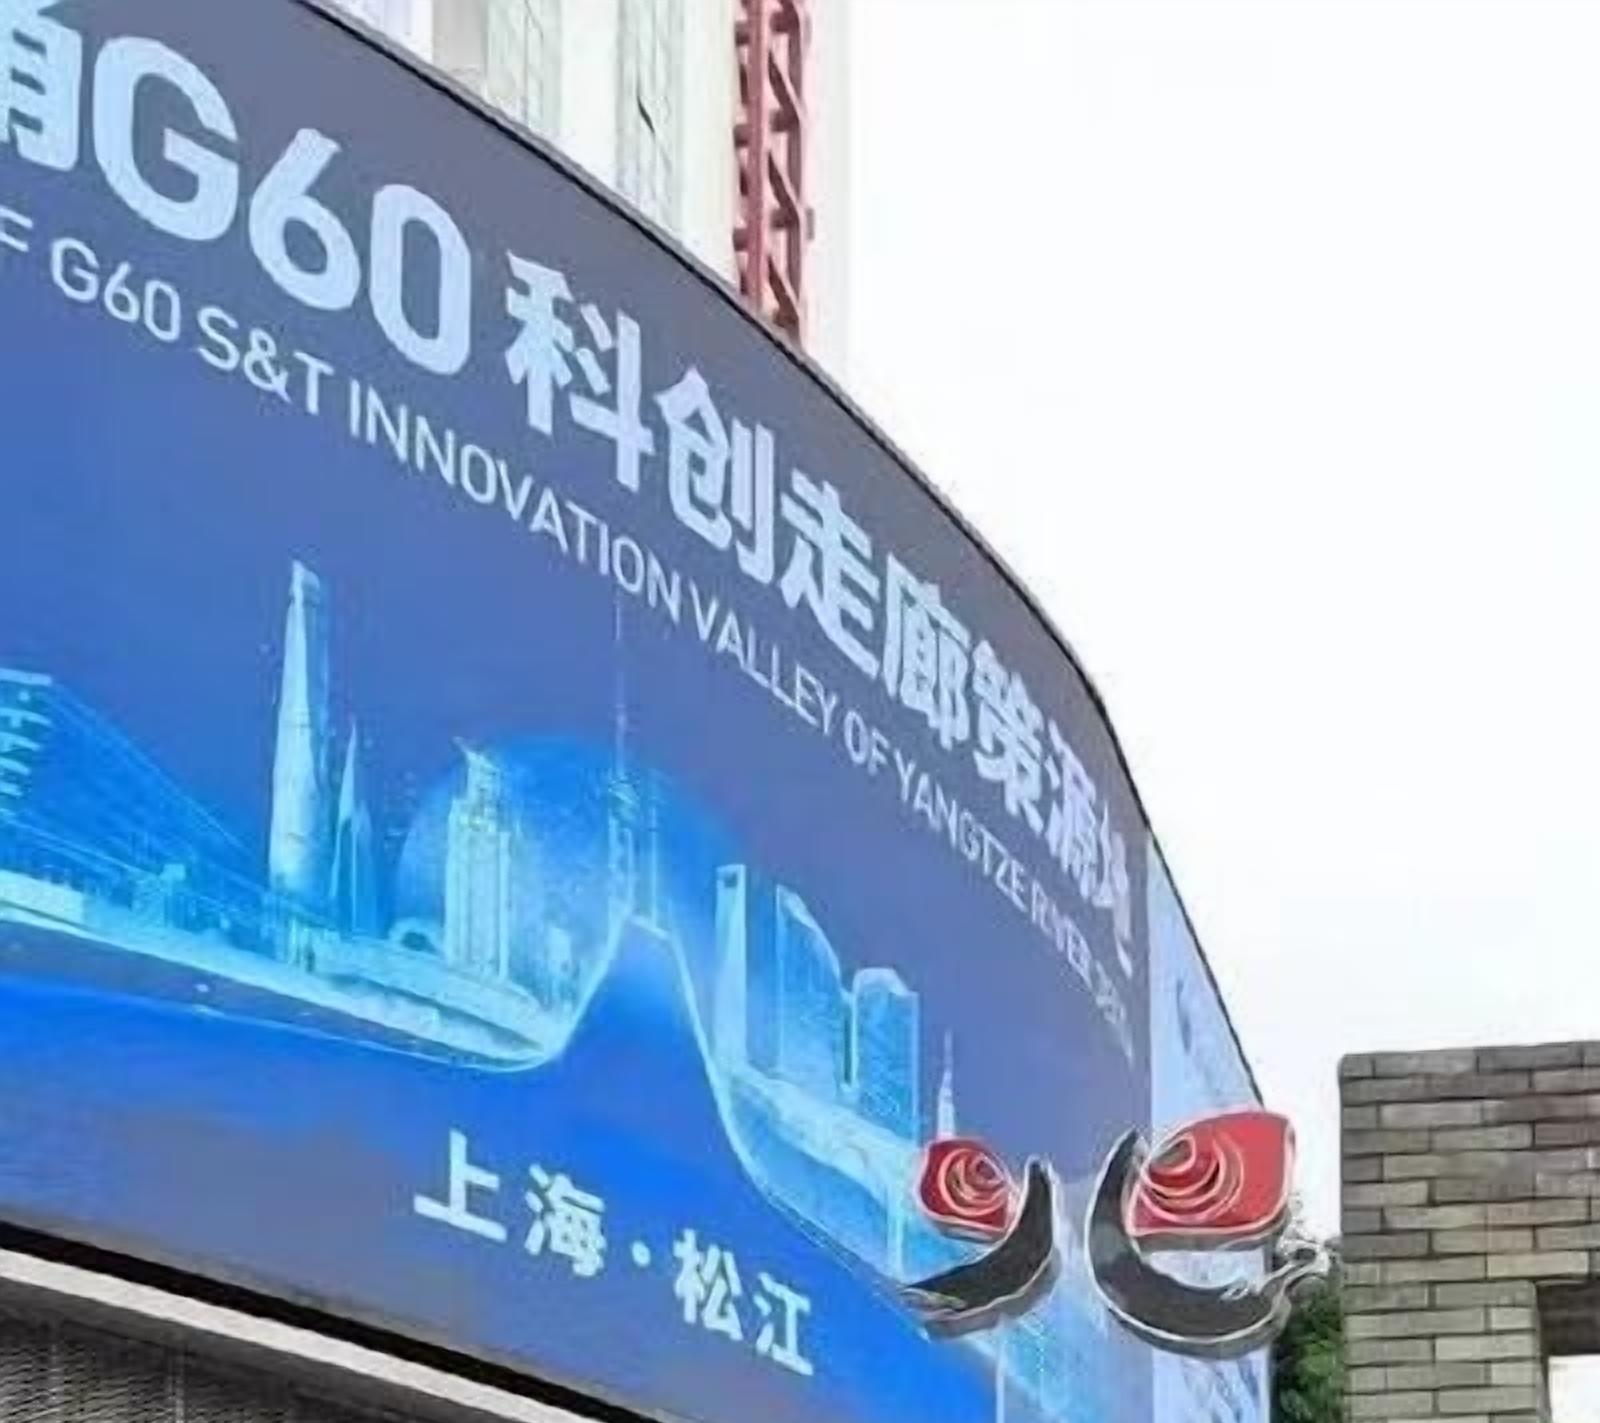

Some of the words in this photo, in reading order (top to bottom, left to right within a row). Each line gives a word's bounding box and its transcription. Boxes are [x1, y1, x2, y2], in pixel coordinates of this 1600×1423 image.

[50, 237, 181, 342] G60
[197, 306, 334, 415] S&T
[349, 379, 681, 626] INNOVATION
[688, 579, 838, 736] VALLEY
[844, 710, 889, 776] OF
[893, 749, 1028, 914] YANGTZE
